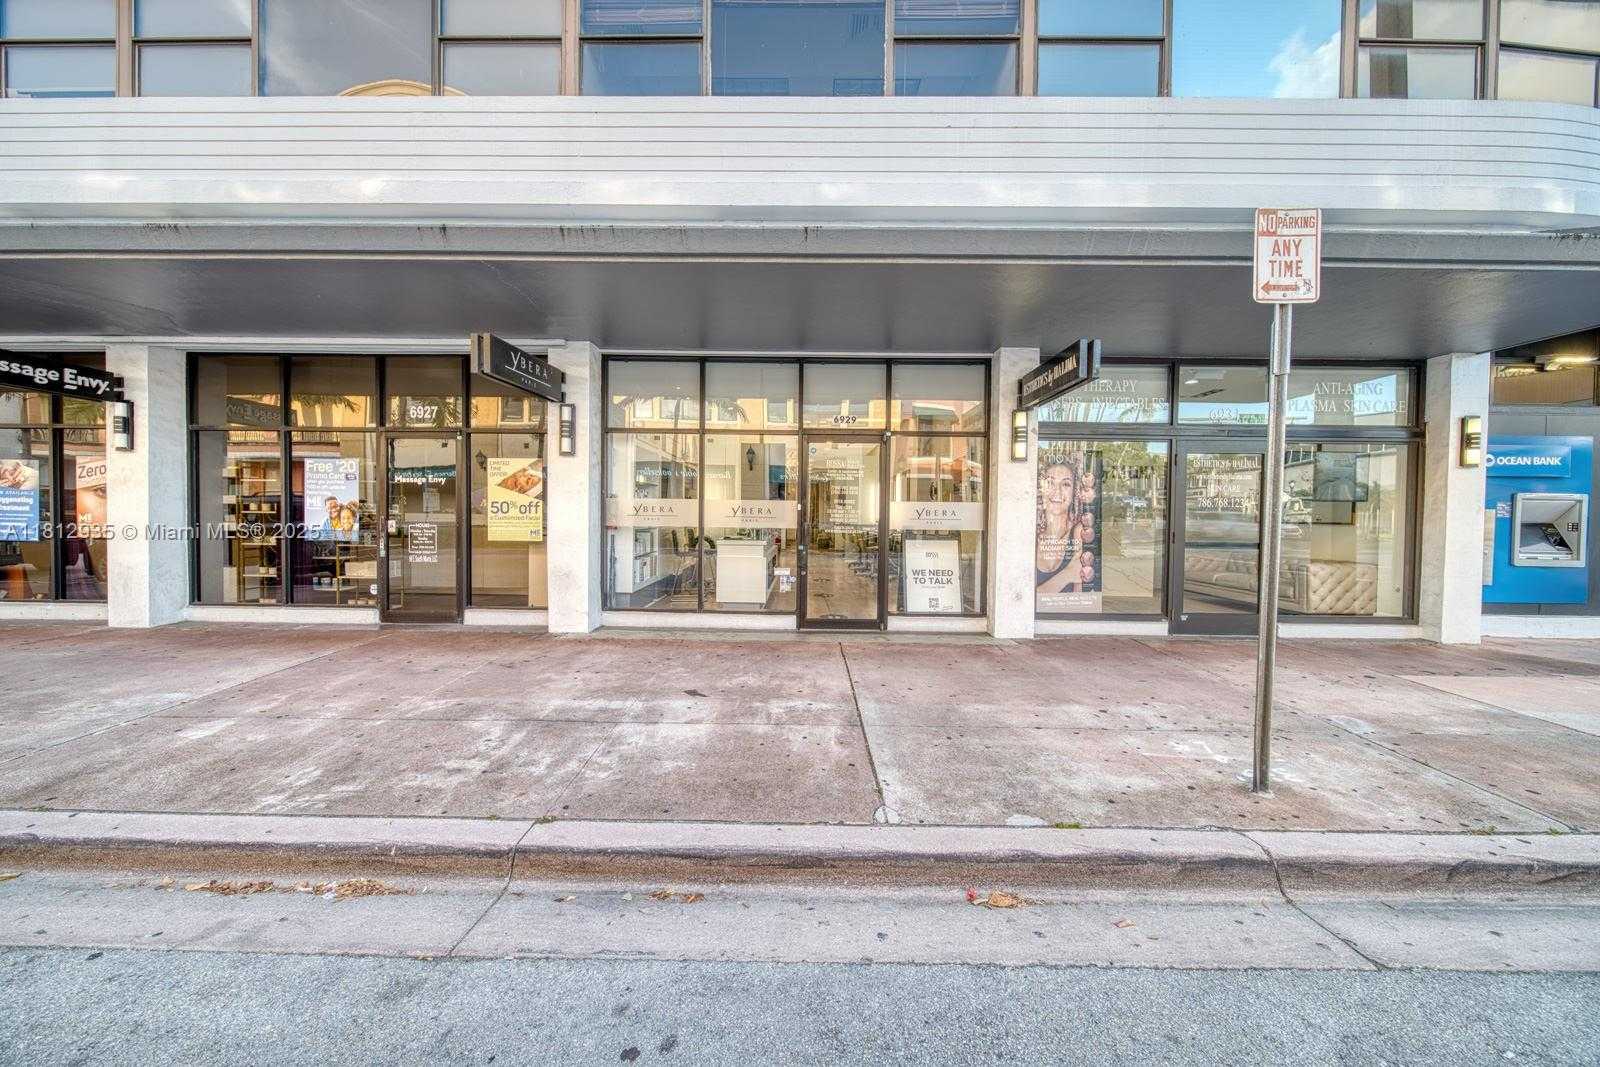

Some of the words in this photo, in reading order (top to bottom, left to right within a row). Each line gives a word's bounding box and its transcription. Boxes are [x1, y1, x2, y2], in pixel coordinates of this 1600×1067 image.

[1260, 214, 1277, 233] NO
[1277, 216, 1315, 229] PARKING
[1272, 239, 1303, 256] ANY
[1269, 260, 1303, 277] TIME
[1314, 382, 1384, 395] ANTI-AGING
[410, 405, 438, 419] 6927
[1287, 400, 1337, 412] PLASMA
[833, 416, 857, 424] 6929
[307, 459, 333, 472] Free
[1497, 456, 1531, 466] OCEAN
[1533, 456, 1562, 466] BANK
[78, 465, 107, 479] Zero
[395, 475, 426, 485] Massage
[429, 474, 447, 485] Envy
[519, 501, 540, 514] off
[633, 503, 674, 516] YBERA
[732, 505, 772, 518] YBERA
[915, 507, 957, 520] YBERA
[912, 569, 927, 577] WE
[928, 569, 954, 577] NEED
